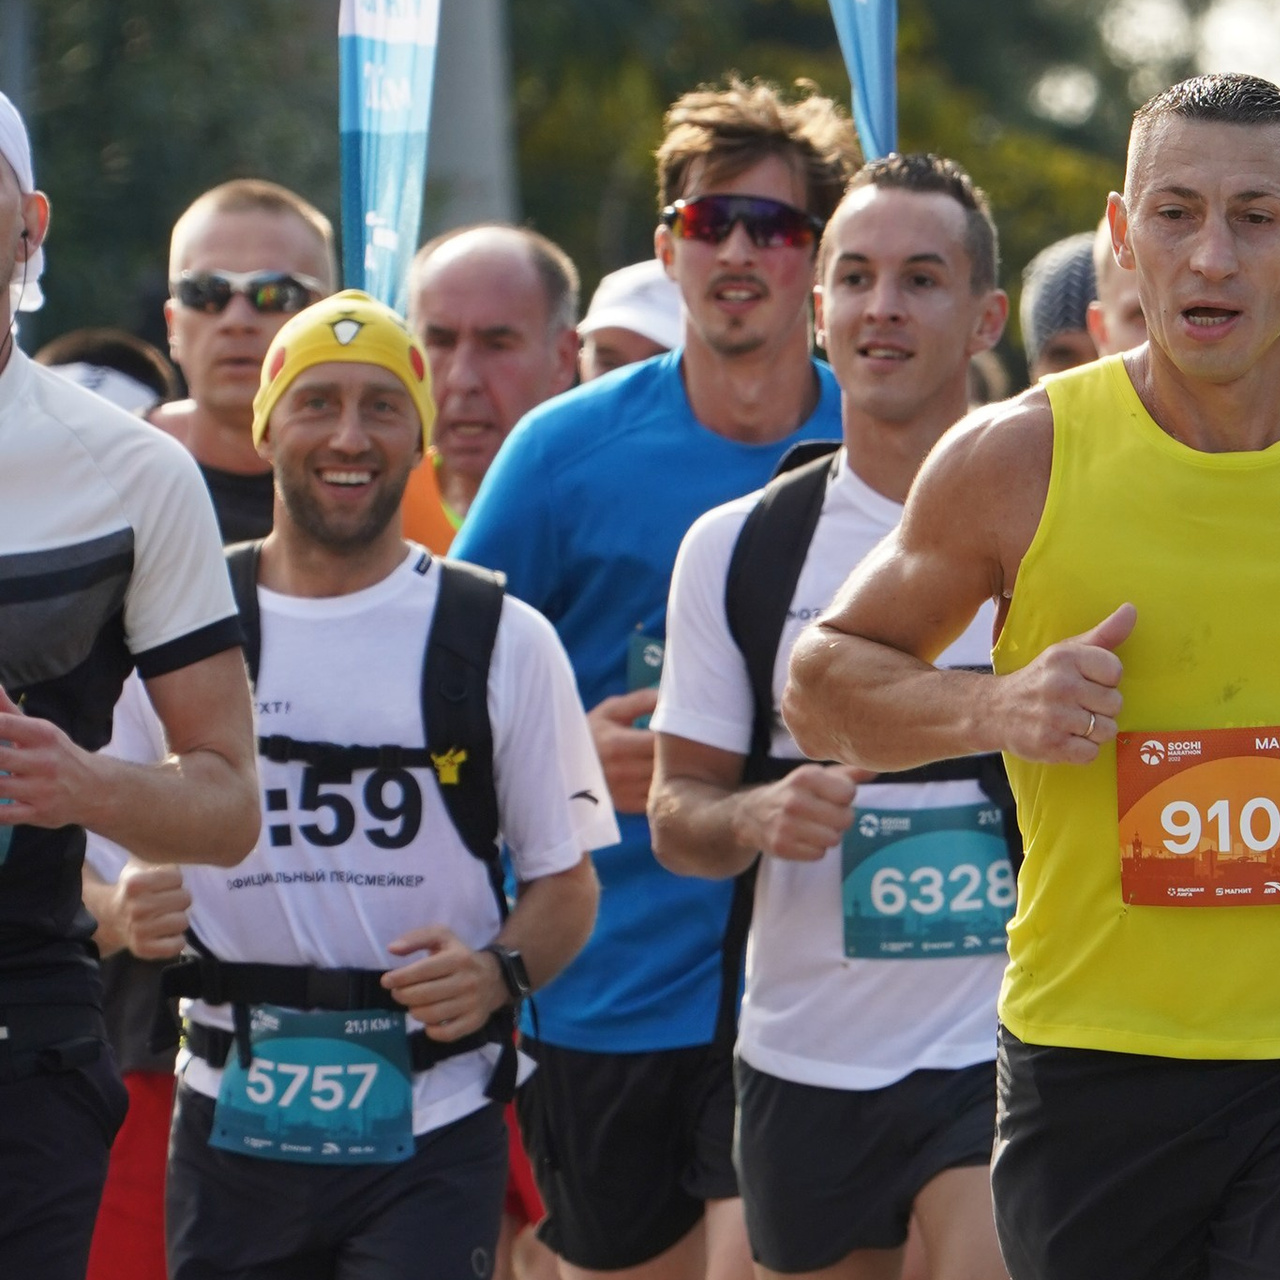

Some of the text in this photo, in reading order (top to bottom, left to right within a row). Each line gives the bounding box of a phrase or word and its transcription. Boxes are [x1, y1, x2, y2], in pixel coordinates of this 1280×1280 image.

[1167, 740, 1201, 751] SOCHI
[1167, 748, 1202, 757] MARATHON
[329, 870, 425, 888] ПЕЙСМЕЙКЕР
[870, 859, 1018, 915] 6328
[1224, 887, 1253, 895] МАГНИТ
[344, 1019, 369, 1035] 21,1
[245, 1056, 379, 1111] 5757
